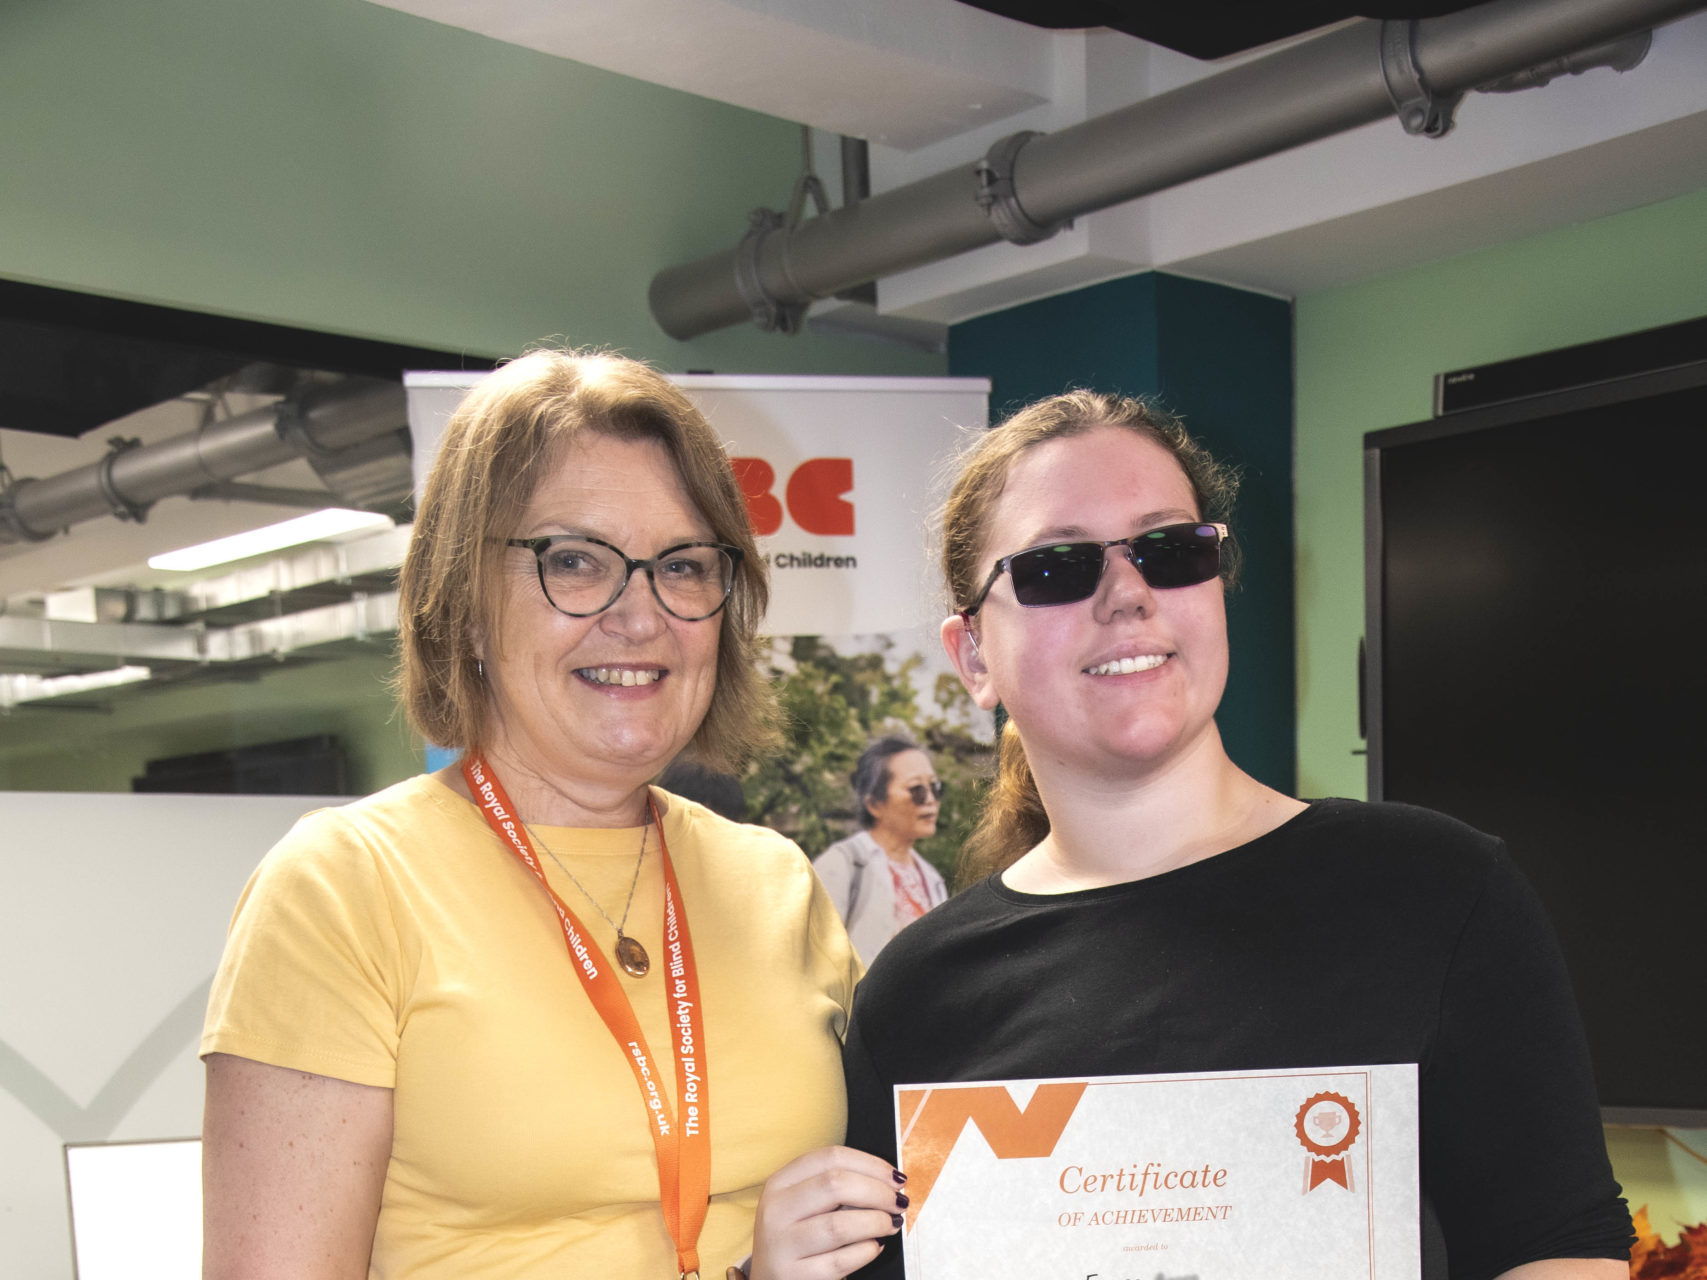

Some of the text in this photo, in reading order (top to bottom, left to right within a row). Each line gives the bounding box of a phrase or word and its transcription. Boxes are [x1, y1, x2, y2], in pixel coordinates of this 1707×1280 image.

[729, 457, 855, 536] BC
[775, 552, 857, 569] Children
[470, 761, 537, 870] The Royal Society
[564, 917, 598, 980] Children
[669, 941, 685, 978] Blind
[673, 979, 688, 999] for
[676, 1000, 694, 1054] Society
[627, 1041, 670, 1136] rsbc.org.uk
[681, 1057, 701, 1103] Royal
[684, 1106, 699, 1137] The
[1059, 1162, 1228, 1197] Certificate
[1058, 1205, 1233, 1227] OF ACHIEVEMENT
[1123, 1243, 1169, 1252] awarded to
